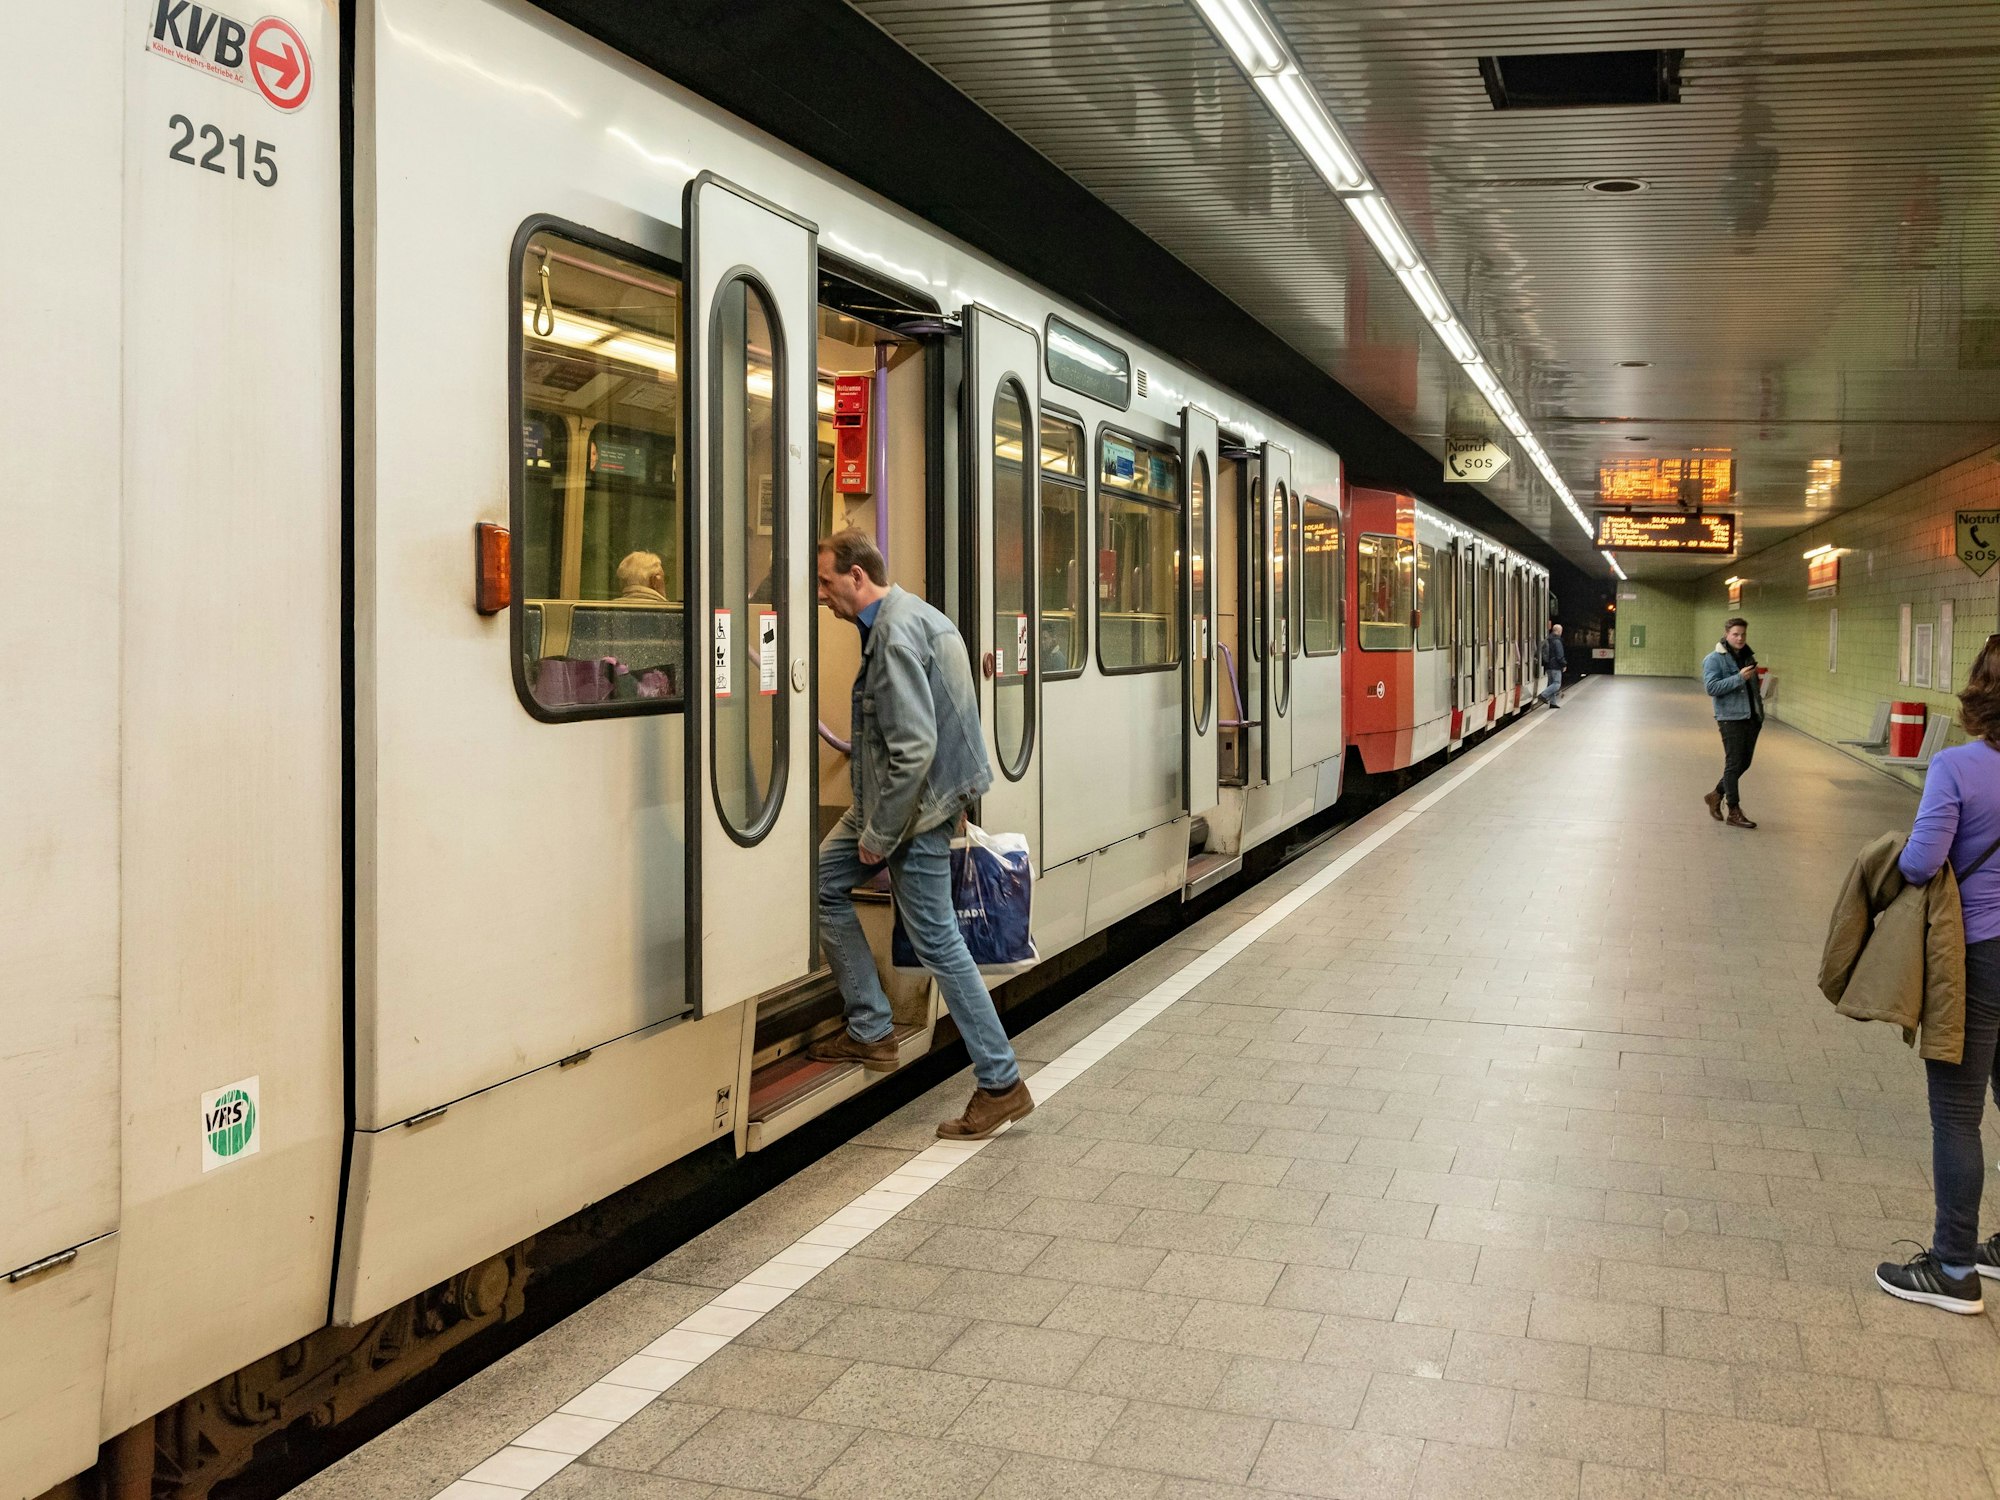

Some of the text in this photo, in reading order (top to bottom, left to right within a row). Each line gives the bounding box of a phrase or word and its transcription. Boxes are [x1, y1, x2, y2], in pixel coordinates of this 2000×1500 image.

[153, 0, 246, 69] KVB
[152, 41, 244, 83] Kölner Verkehrs-Betriebe AG
[169, 114, 278, 187] 2215
[1449, 441, 1486, 452] Notruf
[1464, 458, 1493, 469] SOS
[1651, 516, 1686, 524] 30.04.2019
[1958, 513, 2000, 524] Notruf
[1964, 550, 1997, 561] SOS
[206, 1101, 243, 1133] VRS
